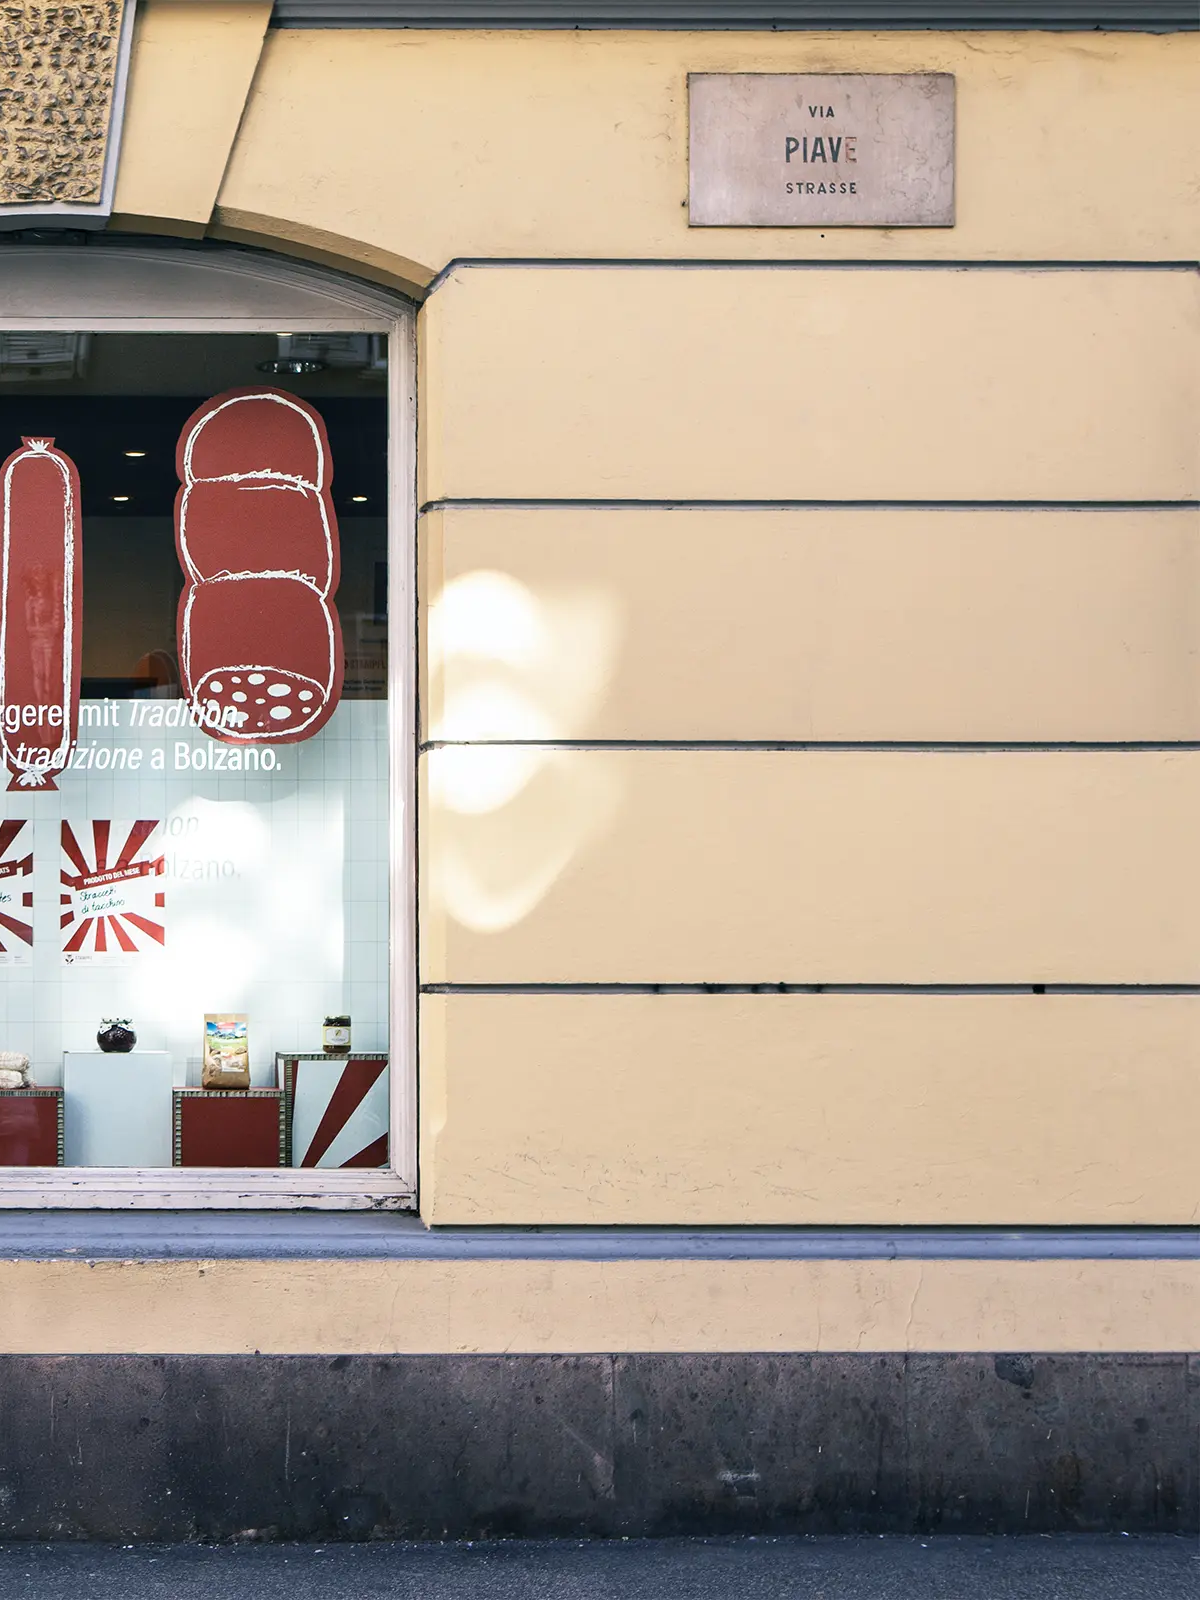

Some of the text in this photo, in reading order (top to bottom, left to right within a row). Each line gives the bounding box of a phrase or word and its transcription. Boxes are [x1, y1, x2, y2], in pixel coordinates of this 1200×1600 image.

[808, 105, 835, 118] VIA
[785, 136, 858, 164] PIAVE
[785, 182, 858, 195] STRASSE
[79, 697, 120, 727] mit
[128, 697, 243, 728] Tradition.
[15, 740, 143, 770] tradizione
[150, 748, 165, 771] a
[174, 740, 282, 771] Bolzano.
[83, 867, 140, 886] PRODOTTO DEL MESE
